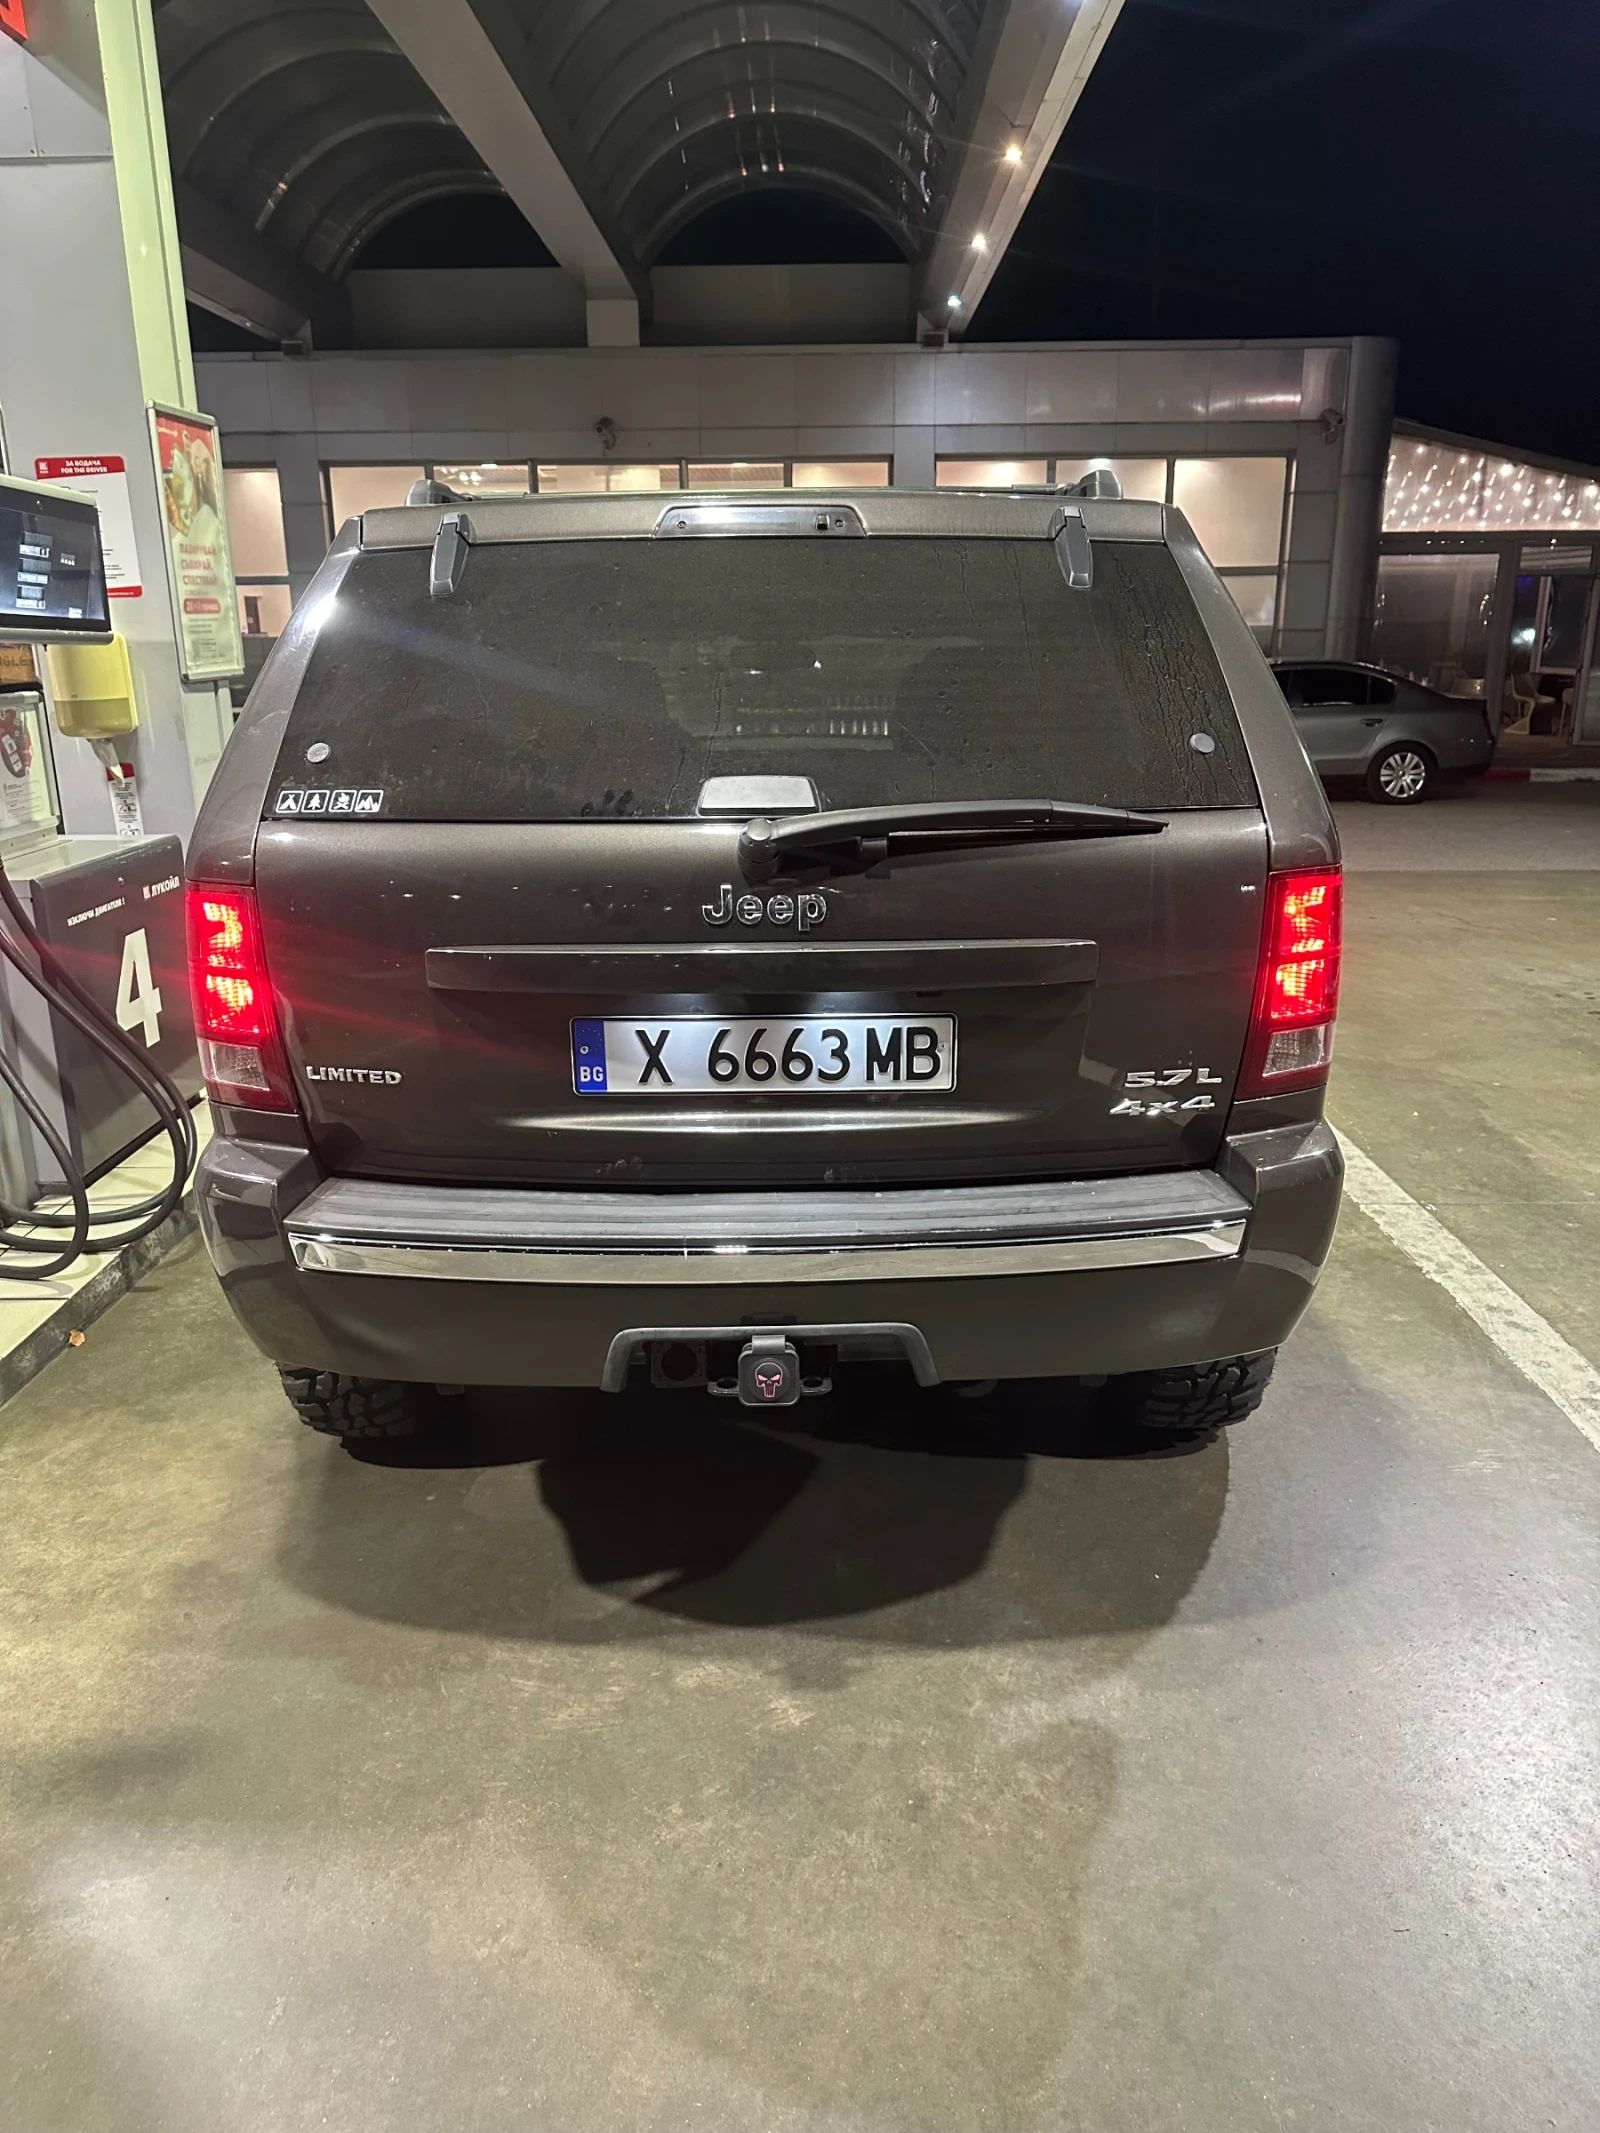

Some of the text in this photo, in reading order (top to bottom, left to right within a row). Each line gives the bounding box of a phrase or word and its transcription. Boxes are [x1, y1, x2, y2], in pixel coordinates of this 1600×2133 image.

[0, 655, 28, 667] GLE
[151, 875, 180, 897] ЛУКОЙЛ
[67, 909, 95, 927] ИЗКЛЮЧИ
[702, 884, 827, 931] Jeep
[116, 927, 162, 1048] 4
[635, 1026, 942, 1084] X 6663 MB
[305, 1065, 402, 1085] LIMITED
[579, 1066, 604, 1082] BG
[1124, 1067, 1222, 1088] 5.7L
[1109, 1095, 1216, 1117] 4x4
